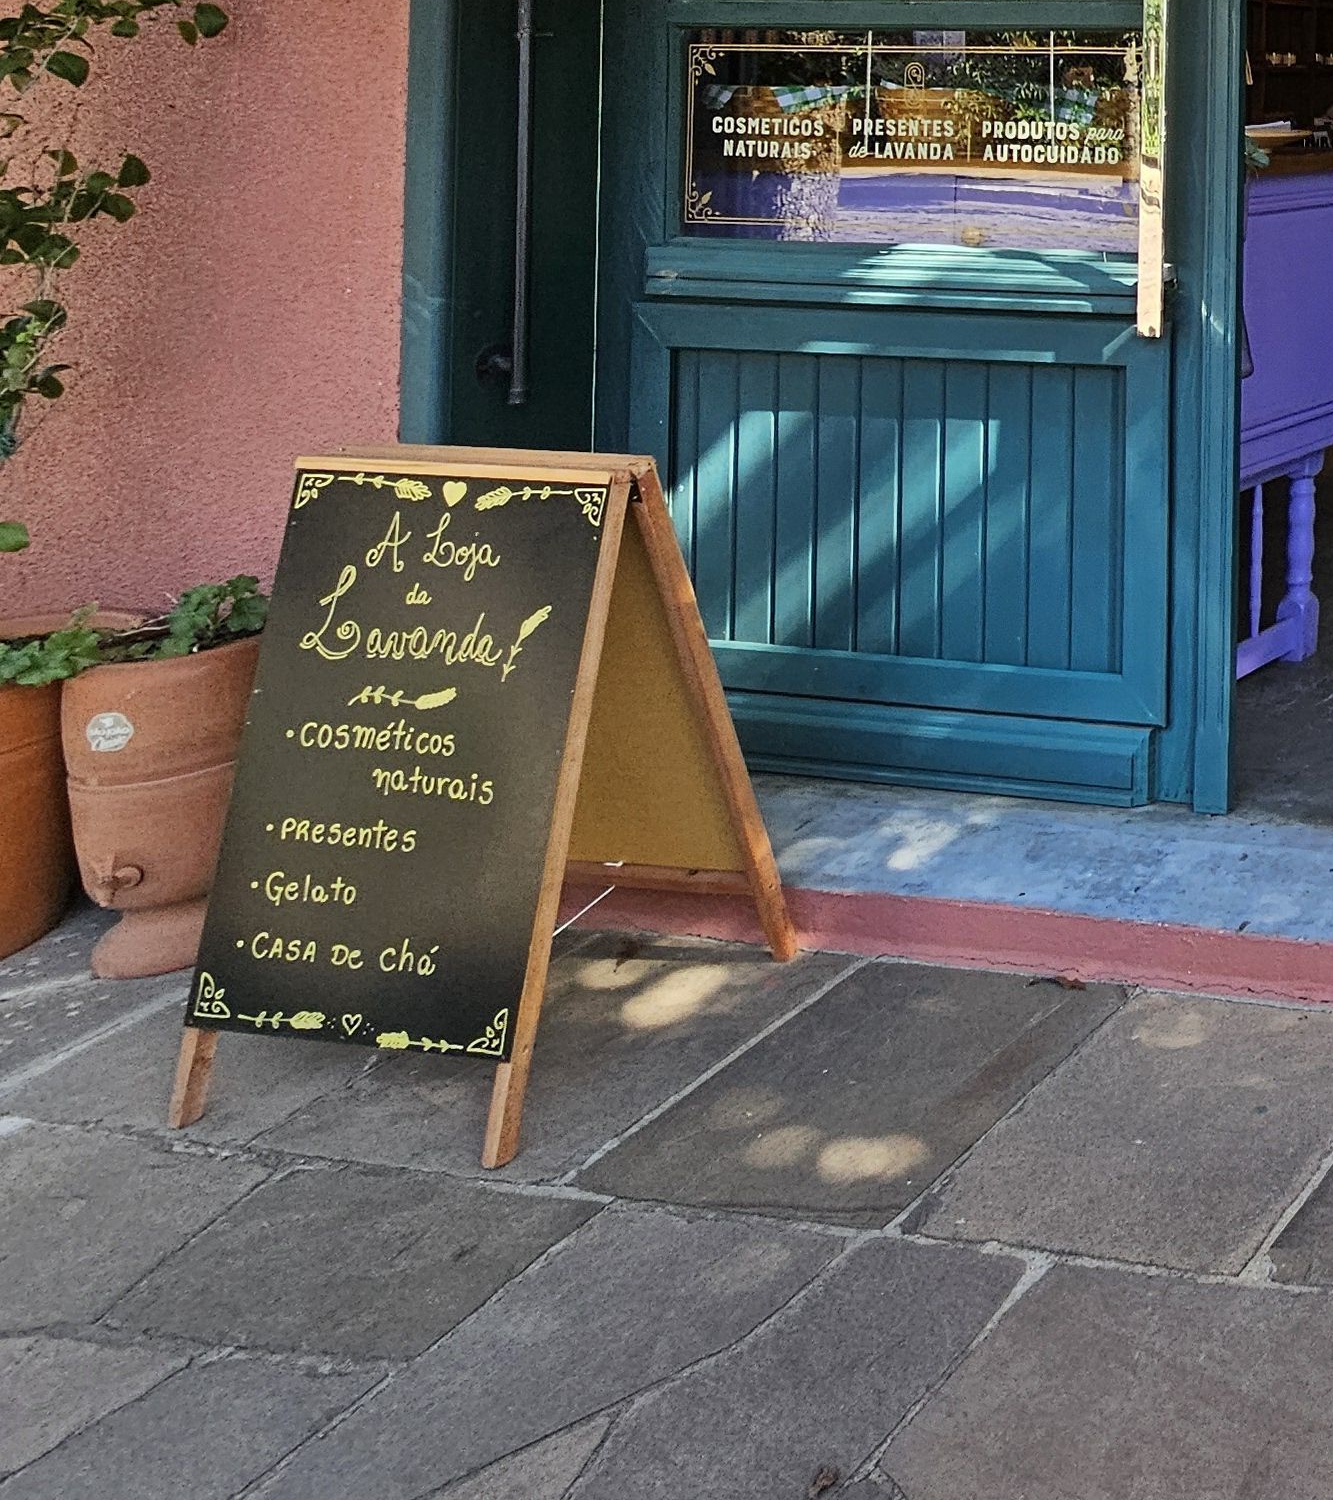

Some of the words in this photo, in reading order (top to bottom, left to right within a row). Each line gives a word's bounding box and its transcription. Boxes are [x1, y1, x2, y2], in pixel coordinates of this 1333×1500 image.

[852, 118, 955, 138] PRESENTES
[981, 120, 1080, 140] PRODUTOS
[1084, 126, 1125, 145] para
[723, 139, 812, 159] NATURAIS
[848, 142, 869, 159] de
[874, 142, 954, 161] LAVANDA
[983, 144, 1120, 165] AUTOCUIDADO
[366, 511, 412, 573] A
[423, 512, 501, 582] Loja
[405, 582, 432, 606] da
[372, 766, 494, 805] naturais
[265, 871, 357, 907] Gelato
[251, 931, 316, 963] CASA
